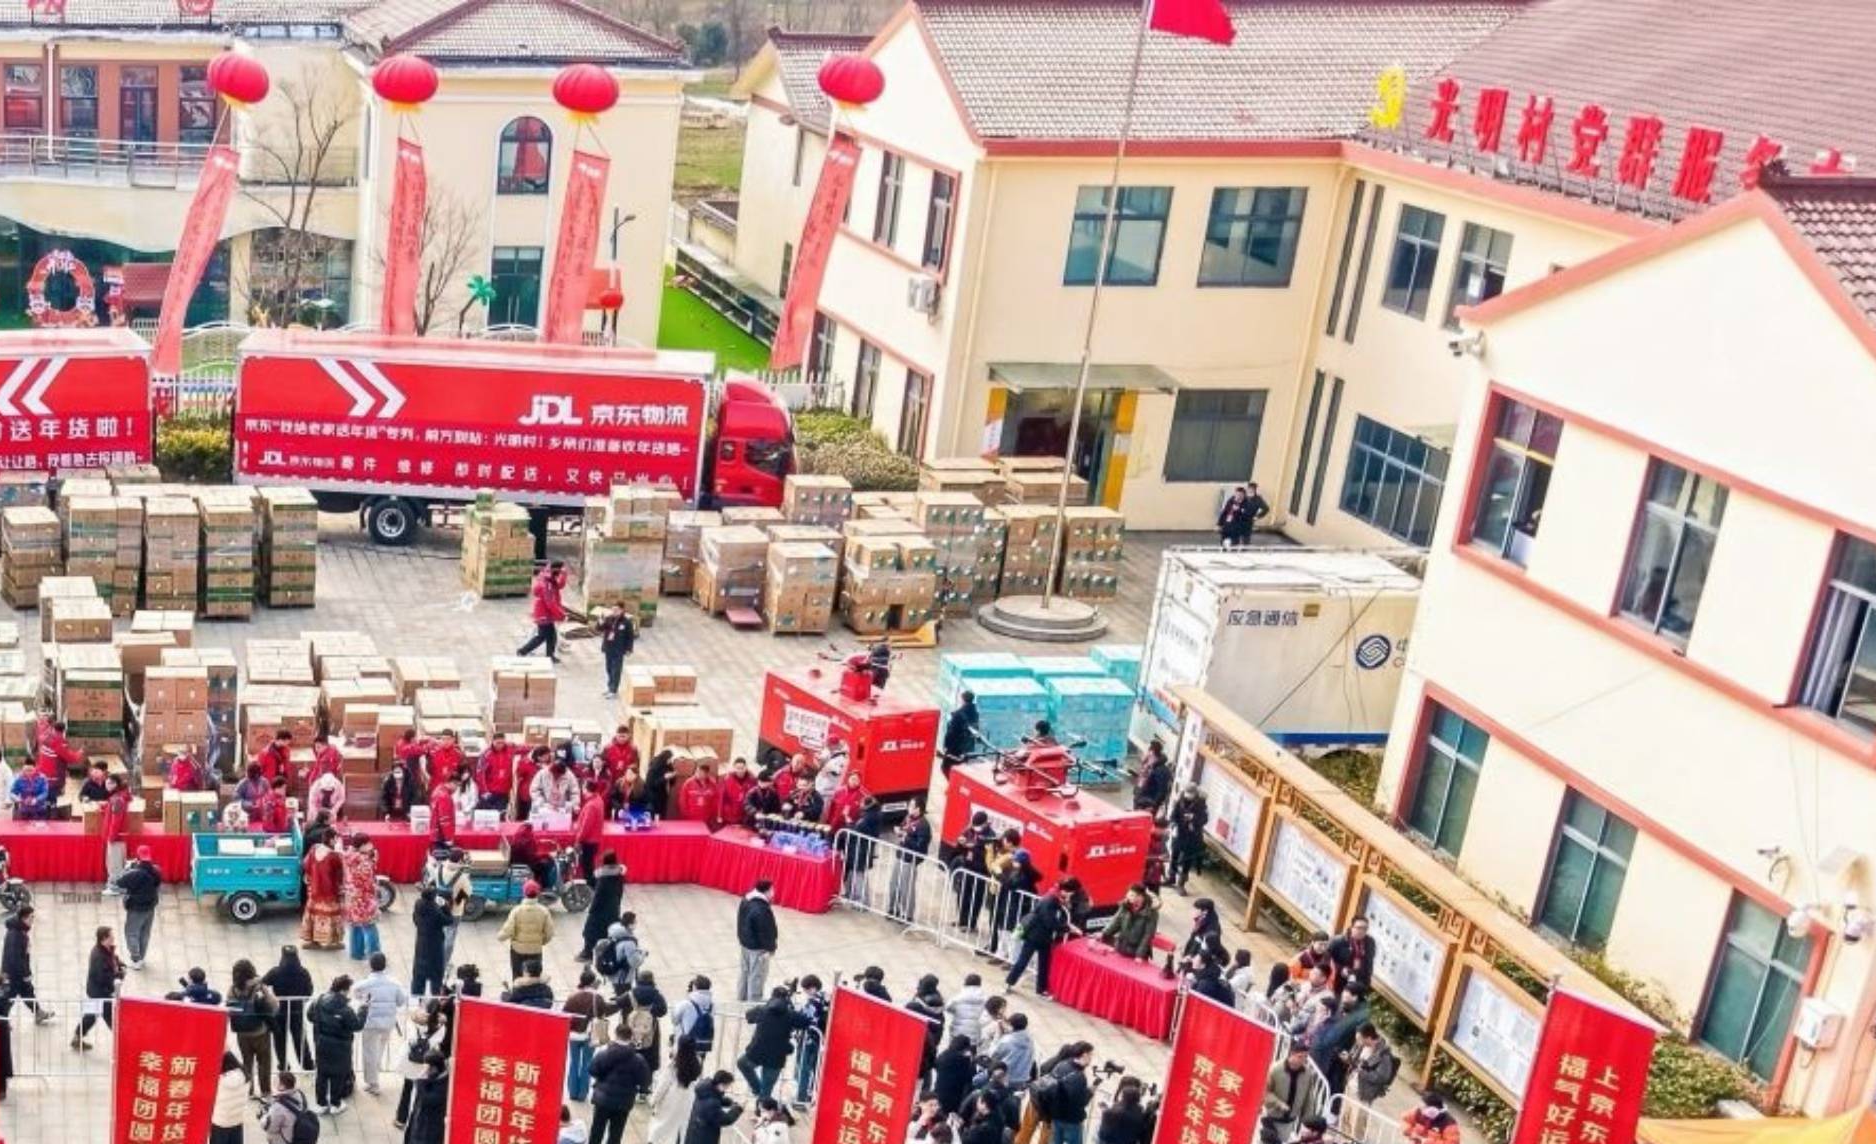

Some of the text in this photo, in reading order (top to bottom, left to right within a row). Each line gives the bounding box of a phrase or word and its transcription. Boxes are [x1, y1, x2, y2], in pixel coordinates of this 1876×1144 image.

[518, 395, 688, 426] JDL 京东物流
[1226, 609, 1299, 627] 应急通信
